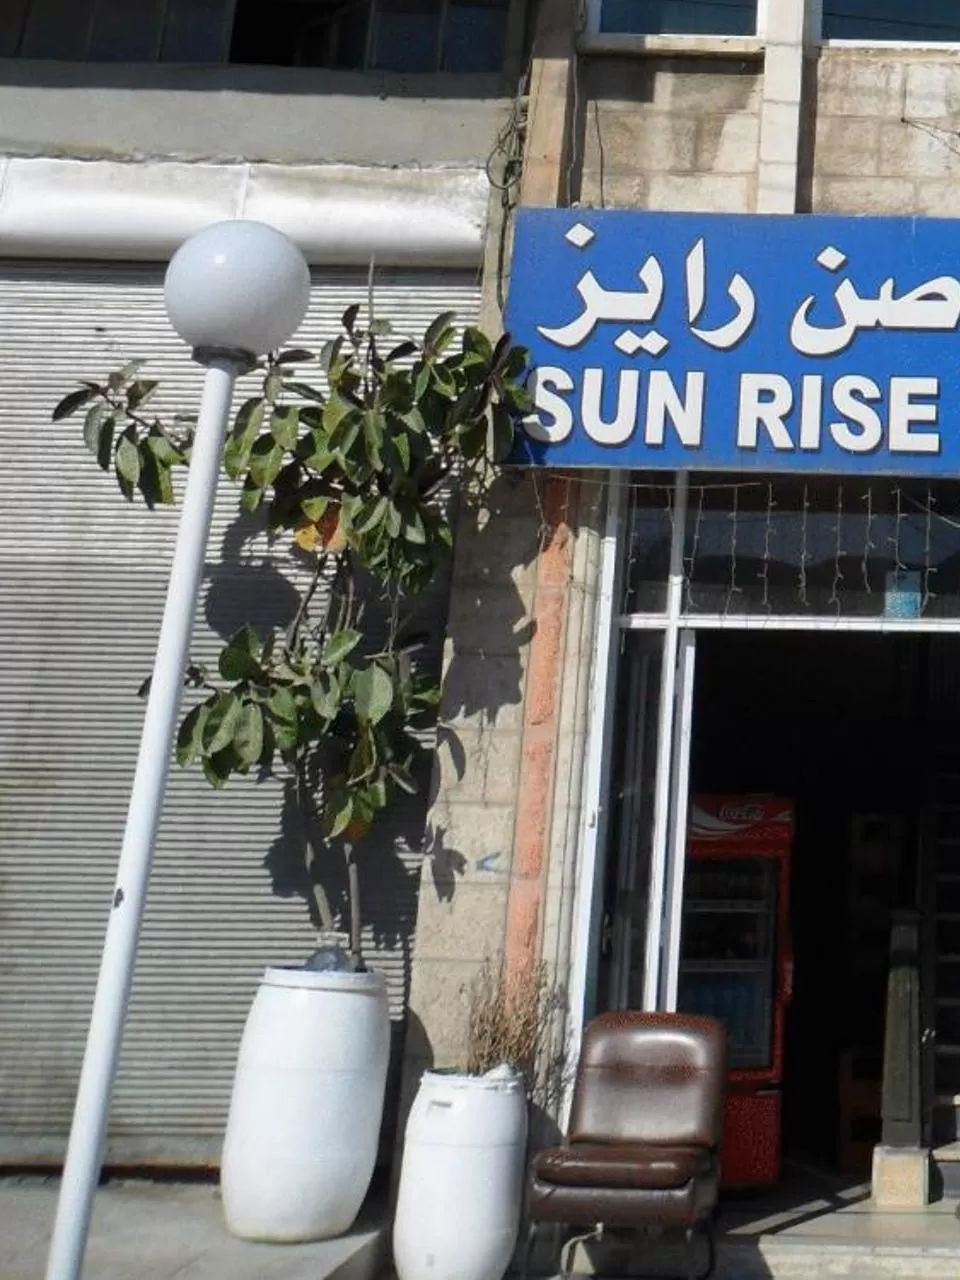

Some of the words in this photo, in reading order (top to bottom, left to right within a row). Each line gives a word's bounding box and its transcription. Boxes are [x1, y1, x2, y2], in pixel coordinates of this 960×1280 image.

[536, 222, 756, 355] رايز
[522, 366, 704, 447] SUN
[736, 373, 940, 453] RISE
